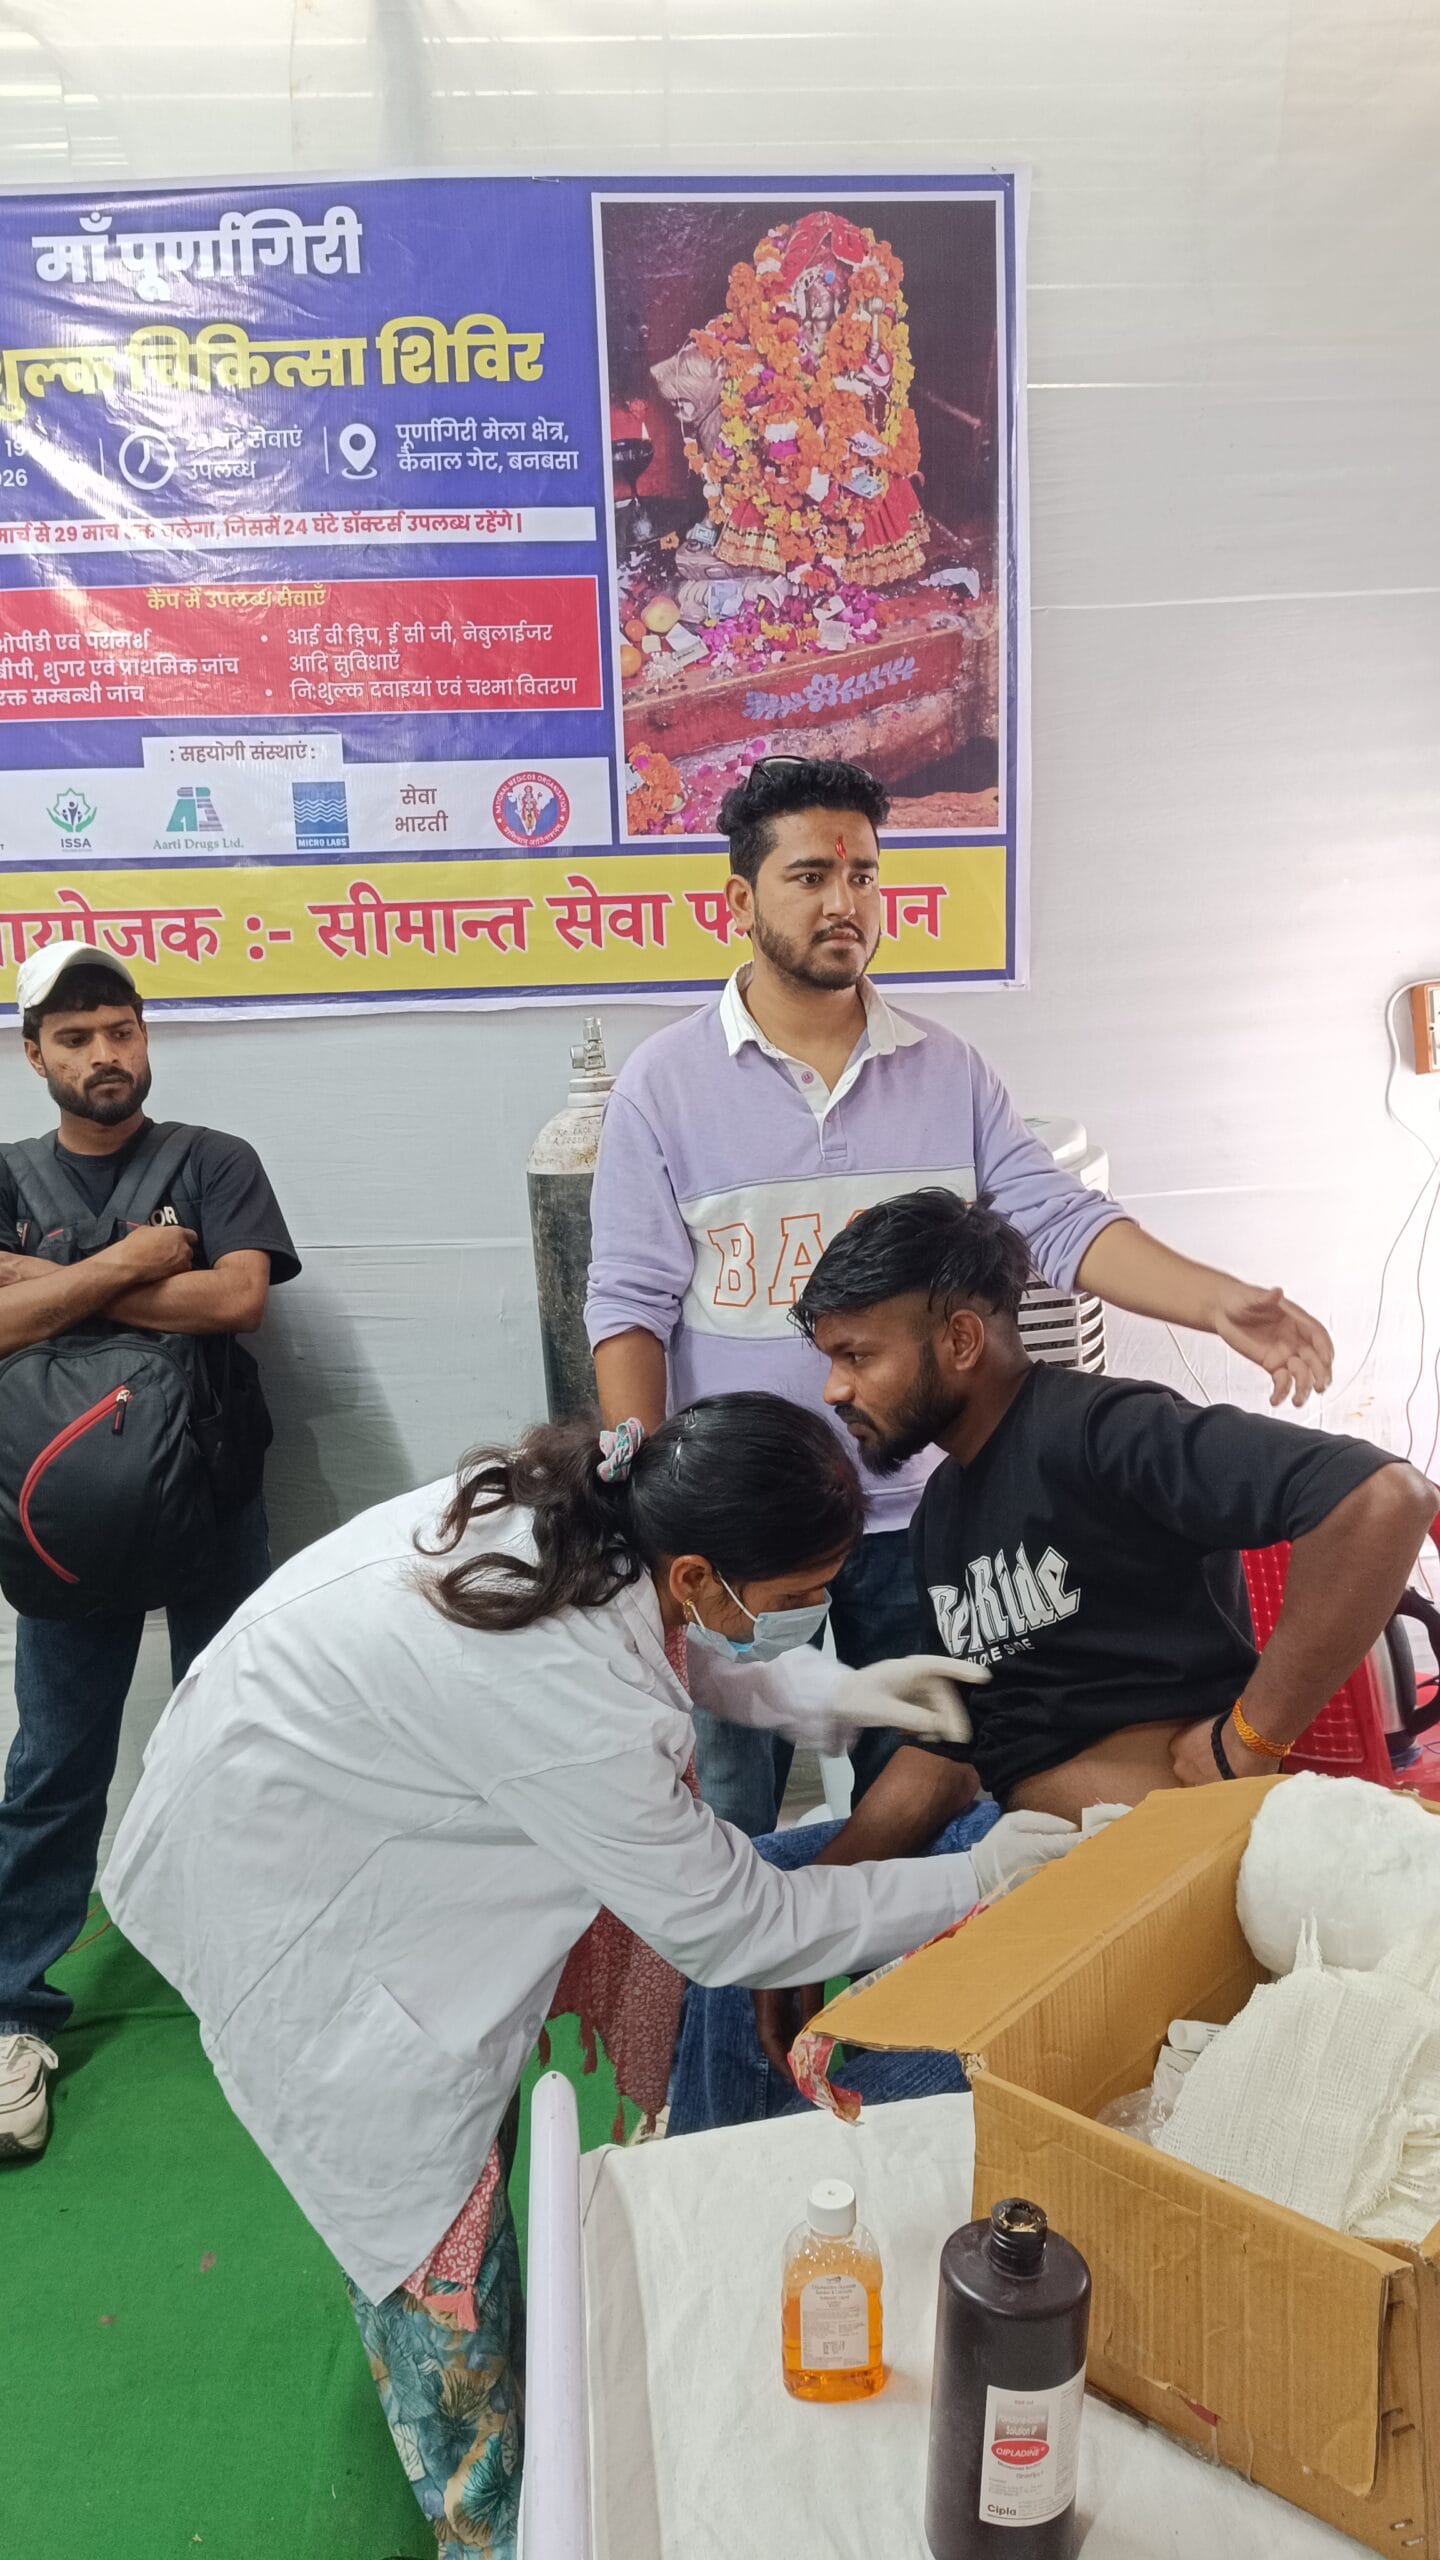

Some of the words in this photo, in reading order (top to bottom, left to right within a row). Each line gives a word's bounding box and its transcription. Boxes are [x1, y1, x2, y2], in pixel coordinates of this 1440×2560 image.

[32, 211, 110, 283] माँ
[116, 205, 363, 302] पूर्णागिरी
[0, 345, 116, 422] ुल्क
[125, 323, 367, 393] चिकित्सा
[376, 313, 545, 385] शिविर
[248, 424, 303, 449] सेवाएं
[395, 417, 477, 450] पूर्णागिरी
[481, 417, 526, 441] मेला
[531, 416, 569, 443] क्षेत्र,
[186, 459, 256, 481] उपलब्ध
[397, 443, 462, 472] कैनाल
[466, 447, 503, 473] गेट,
[507, 450, 579, 470] बनबसा
[0, 468, 28, 487] 26
[34, 520, 51, 543] से
[54, 526, 77, 542] 29
[225, 515, 280, 538] जिसमें
[284, 520, 307, 534] 24
[312, 513, 339, 533] घंटे
[342, 511, 402, 533] डॉक्टर्स
[406, 514, 470, 531] उपलब्ध
[184, 586, 201, 609] में
[204, 589, 272, 609] उपलब्ध
[54, 629, 80, 651] एवं
[84, 628, 152, 651] परामर्श
[288, 623, 319, 645] आई
[324, 623, 344, 644] वी
[346, 624, 383, 648] ड्रिप,
[387, 621, 401, 645] ई
[403, 621, 426, 643] सी
[429, 622, 457, 645] जी,
[460, 620, 554, 648] नेबुलाईजर
[43, 659, 86, 685] शुगर
[90, 656, 116, 678] एवं
[118, 652, 198, 677] प्राथमिक
[200, 653, 240, 675] जांच
[288, 651, 329, 673] आदि
[332, 648, 401, 678] सुविधाएँ
[31, 683, 102, 707] सम्बन्धी
[105, 682, 145, 703] जांच
[368, 675, 432, 699] दवाइयां
[436, 674, 462, 697] एवं
[466, 678, 513, 697] चश्मा
[516, 673, 577, 696] वितरण
[178, 740, 246, 764] सहयोगी
[249, 740, 308, 761] संस्थाएं
[400, 784, 438, 806] सेवा
[395, 809, 449, 833] भारती
[60, 838, 92, 849] ISSA
[152, 838, 182, 851] Aarti
[185, 838, 220, 852] Drugs
[222, 837, 244, 850] Ltd.
[298, 836, 326, 848] MICRO
[326, 836, 347, 847] LABS
[307, 881, 535, 958] सीमान्त
[545, 874, 673, 950] सेवा
[149, 1206, 178, 1227] OR
[995, 2446, 1040, 2458] CIPLADINE
[987, 2504, 1017, 2517] Cipla
